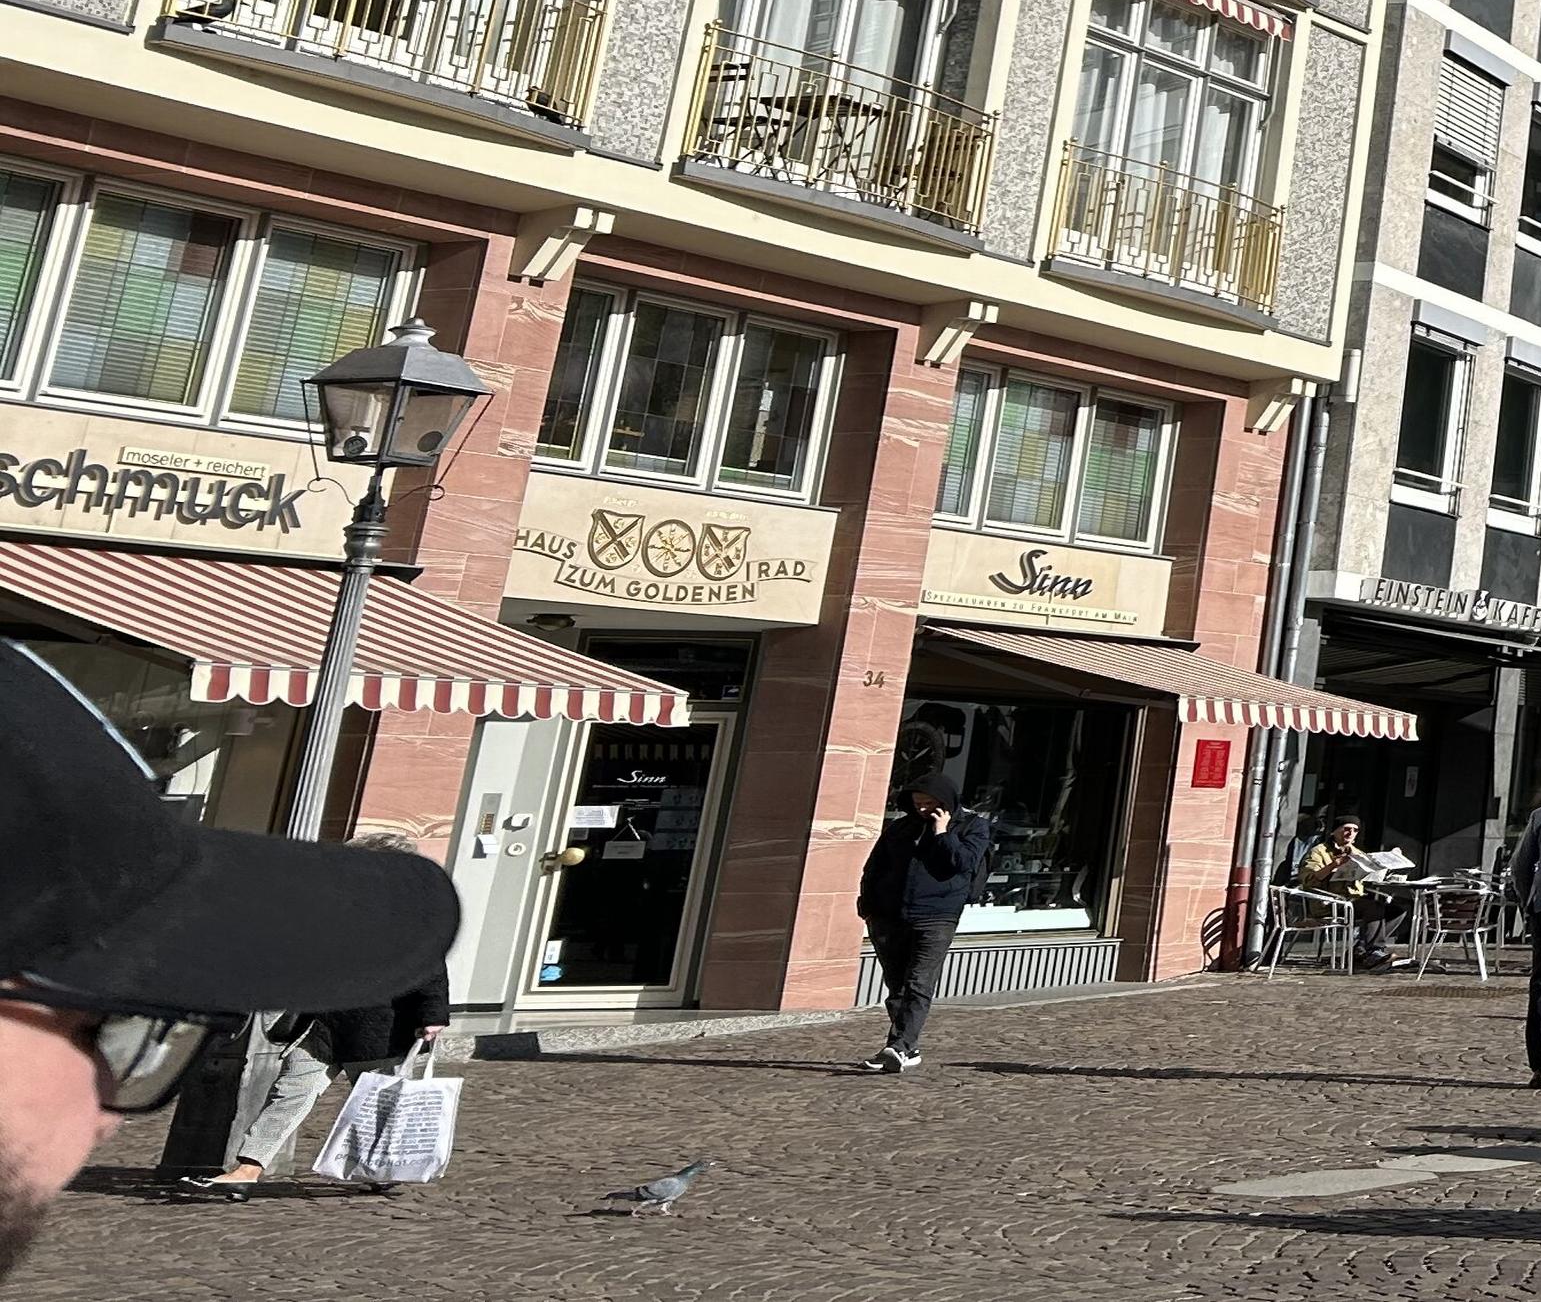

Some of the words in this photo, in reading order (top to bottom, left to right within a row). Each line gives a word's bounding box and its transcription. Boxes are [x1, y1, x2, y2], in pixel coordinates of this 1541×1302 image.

[125, 450, 190, 468] moseler
[206, 461, 266, 478] reichert
[515, 529, 577, 559] HAUS
[565, 564, 616, 593] ZUM
[626, 580, 756, 602] GOLDENEN
[757, 560, 806, 578] RAD
[988, 549, 1093, 601] Sinn
[1375, 578, 1469, 615] EINSTEIN
[862, 670, 886, 688] 34
[616, 770, 667, 784] Sinn
